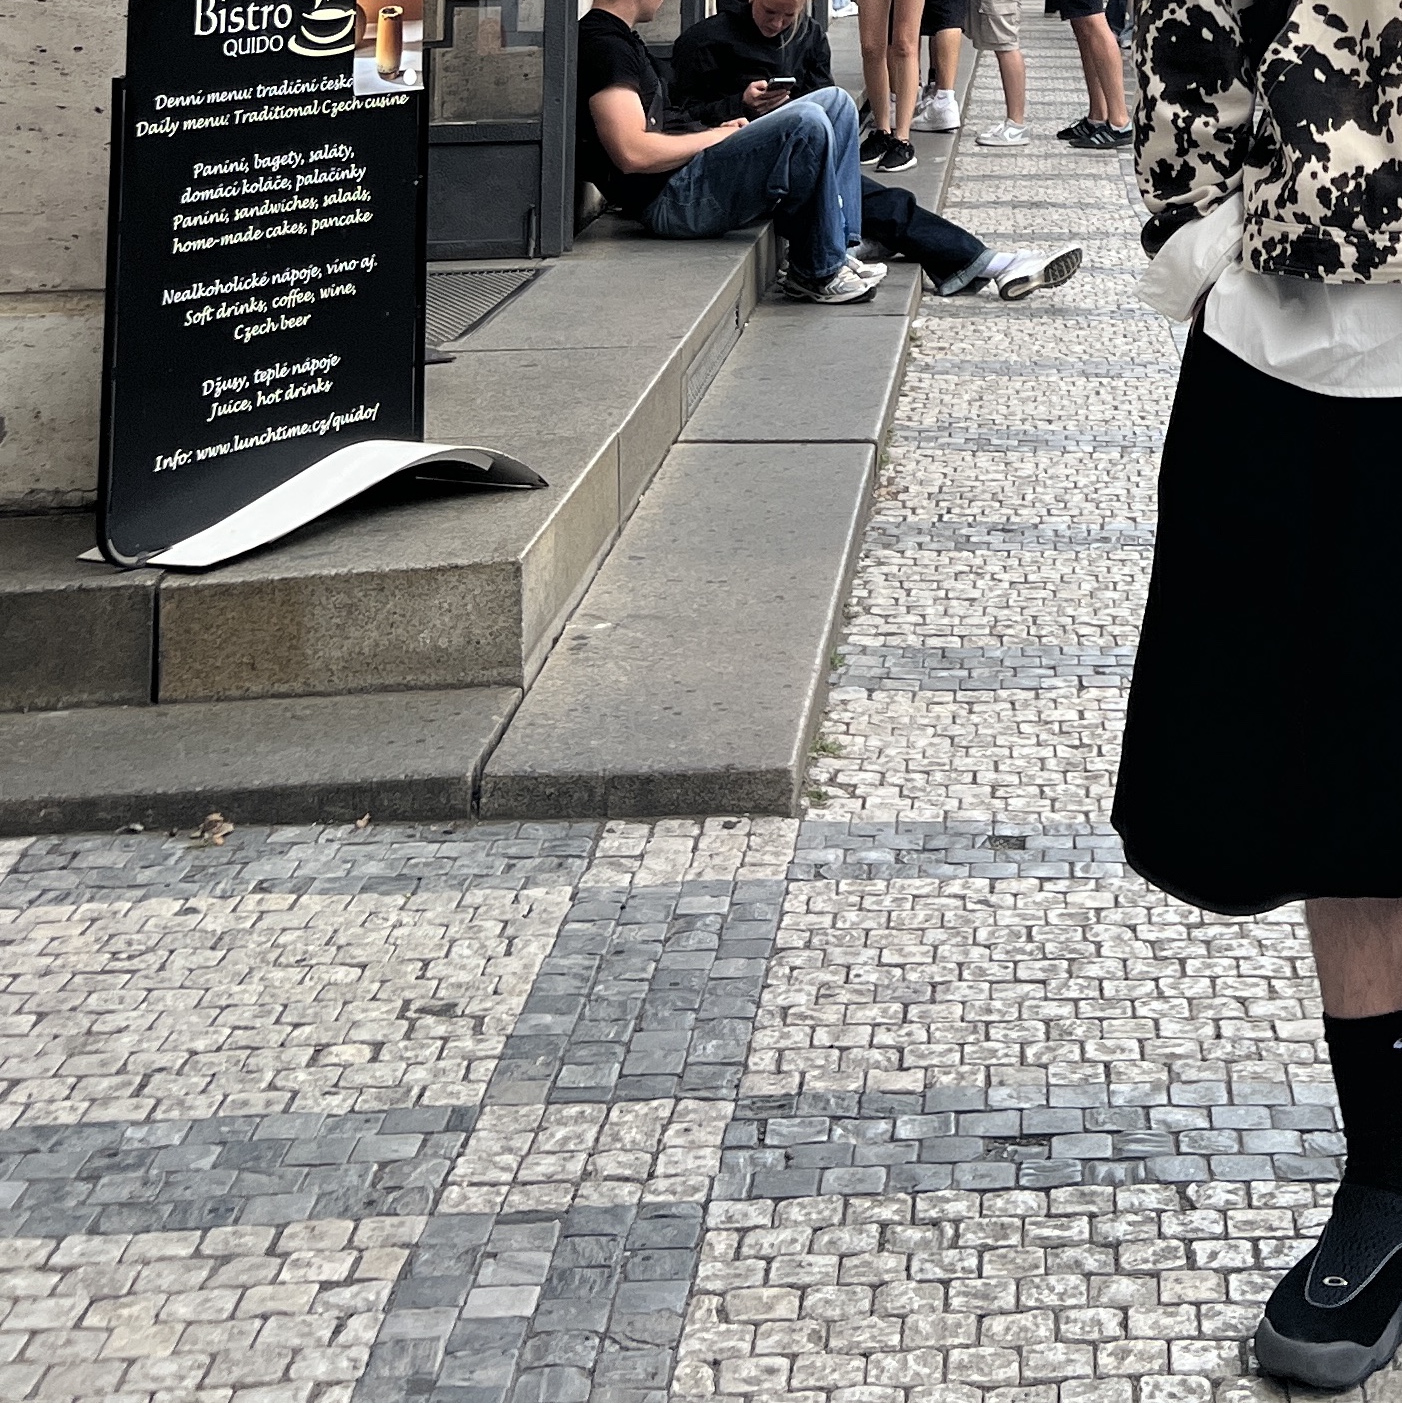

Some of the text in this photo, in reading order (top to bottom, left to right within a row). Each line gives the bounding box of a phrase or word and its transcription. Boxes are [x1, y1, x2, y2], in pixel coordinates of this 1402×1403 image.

[223, 35, 284, 57] QUIDO
[155, 89, 204, 110] Denní
[207, 87, 253, 103] menu:
[256, 75, 319, 98] tradiční
[136, 93, 409, 138] Daily menu: Traditional Czech cusine
[193, 143, 355, 178] Panini, bagety, saláty,
[180, 163, 366, 204] domácí koláče, palačinky
[173, 186, 371, 231] Panini, sandwiches, salads,
[172, 209, 373, 254] home-made cakes, pancake
[162, 253, 378, 305] Nealkoholické nápoje, víno aj.
[184, 282, 356, 327] Soft drinks, coffee, wine,
[233, 313, 312, 343] Czech beer
[202, 353, 342, 398] Džusy, teplé nápoje
[207, 378, 333, 422] Juice, hot drinks
[153, 402, 380, 473] Info: www.lunchtime.cz/quido/
